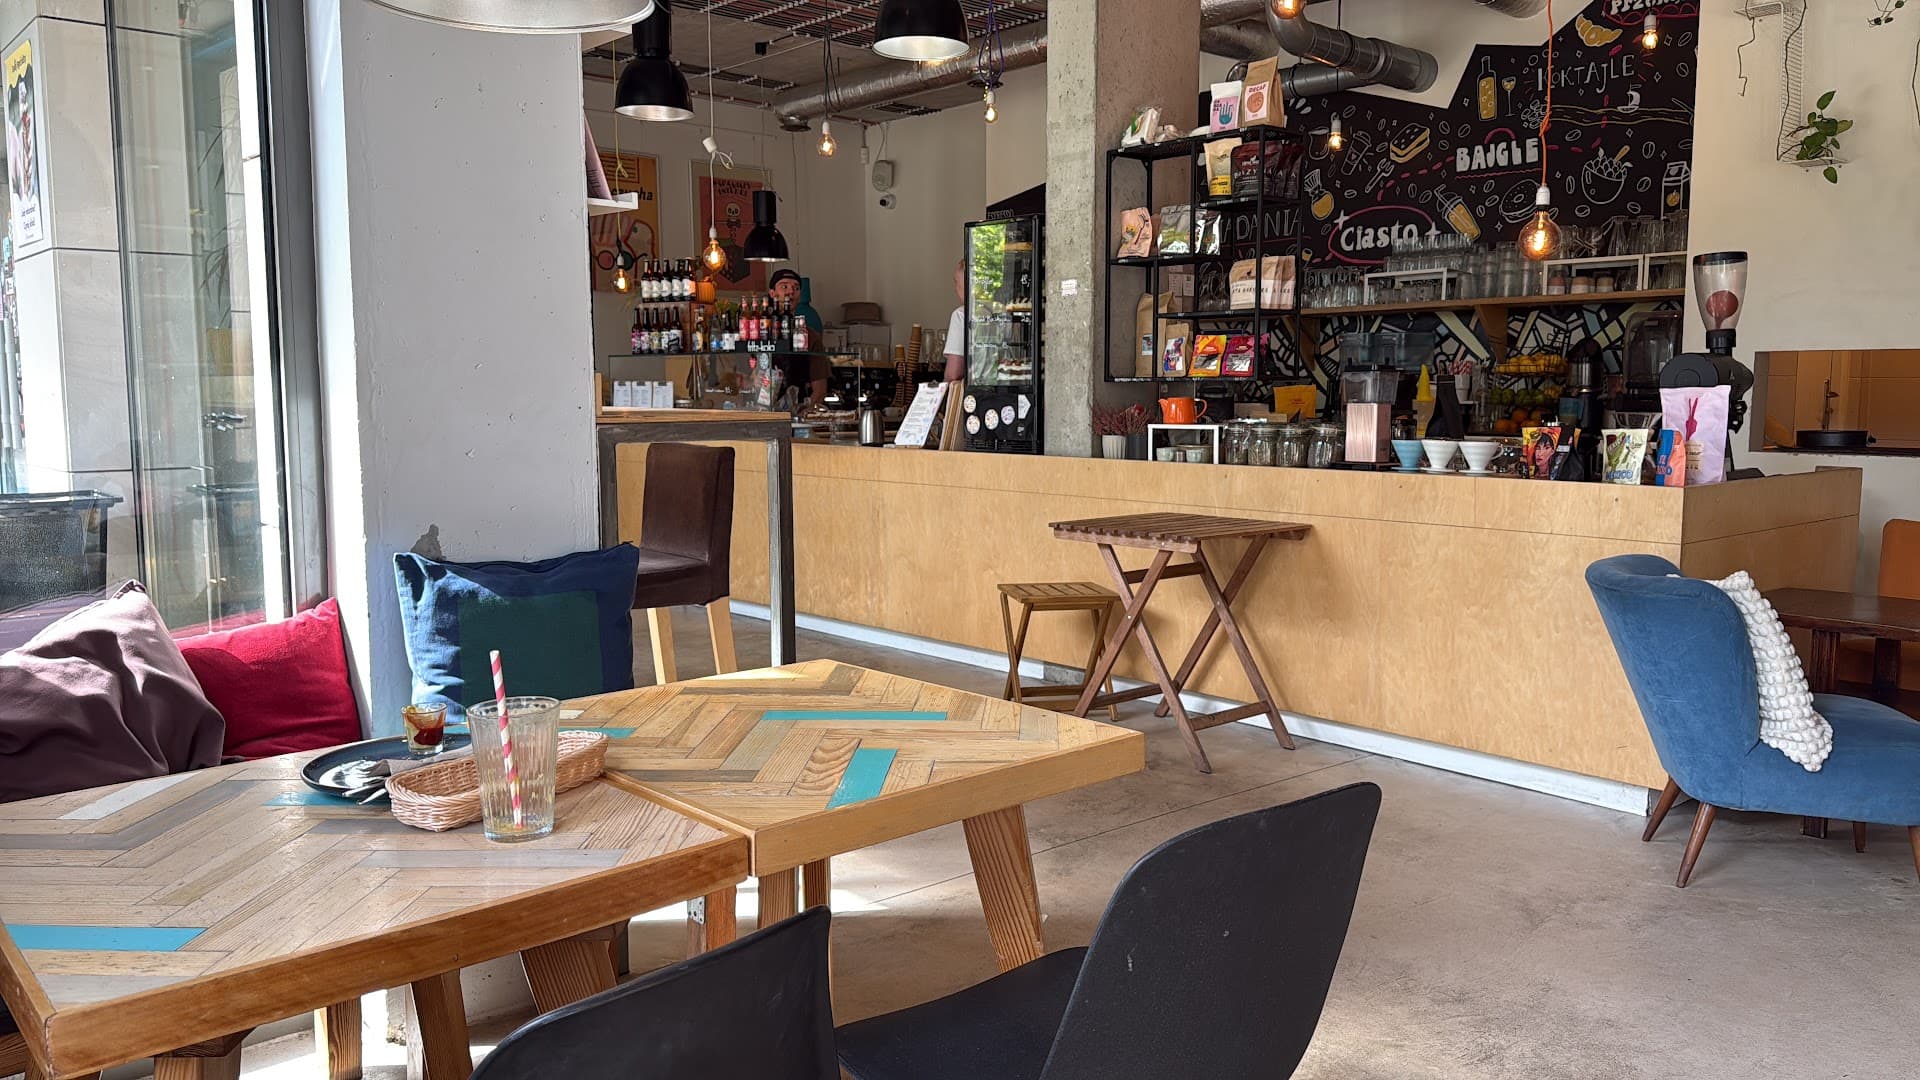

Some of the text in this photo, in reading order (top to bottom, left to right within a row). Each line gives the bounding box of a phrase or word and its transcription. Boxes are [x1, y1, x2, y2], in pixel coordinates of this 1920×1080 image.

[1536, 55, 1635, 93] KOKTAJLE
[1455, 138, 1540, 173] BAJGLE
[1340, 222, 1419, 252] Ciasto
